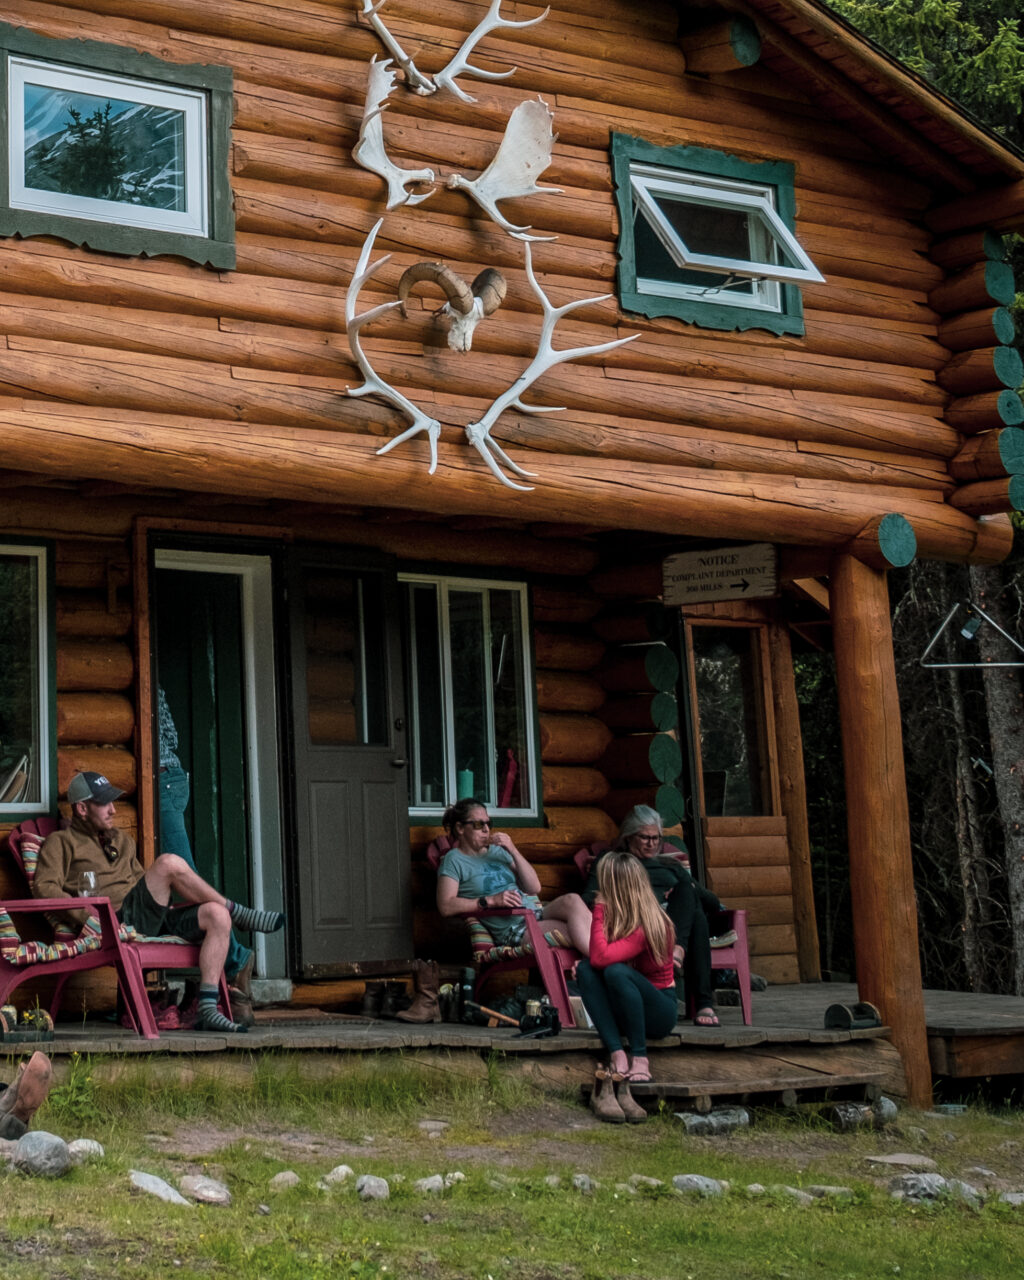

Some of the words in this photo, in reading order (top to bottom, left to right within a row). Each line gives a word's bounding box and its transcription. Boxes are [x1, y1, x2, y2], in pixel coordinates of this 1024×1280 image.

[698, 554, 739, 566] NOTICE
[672, 571, 713, 582] COMPLAINT
[716, 567, 766, 577] DEPARTMENT
[700, 584, 723, 592] MILES
